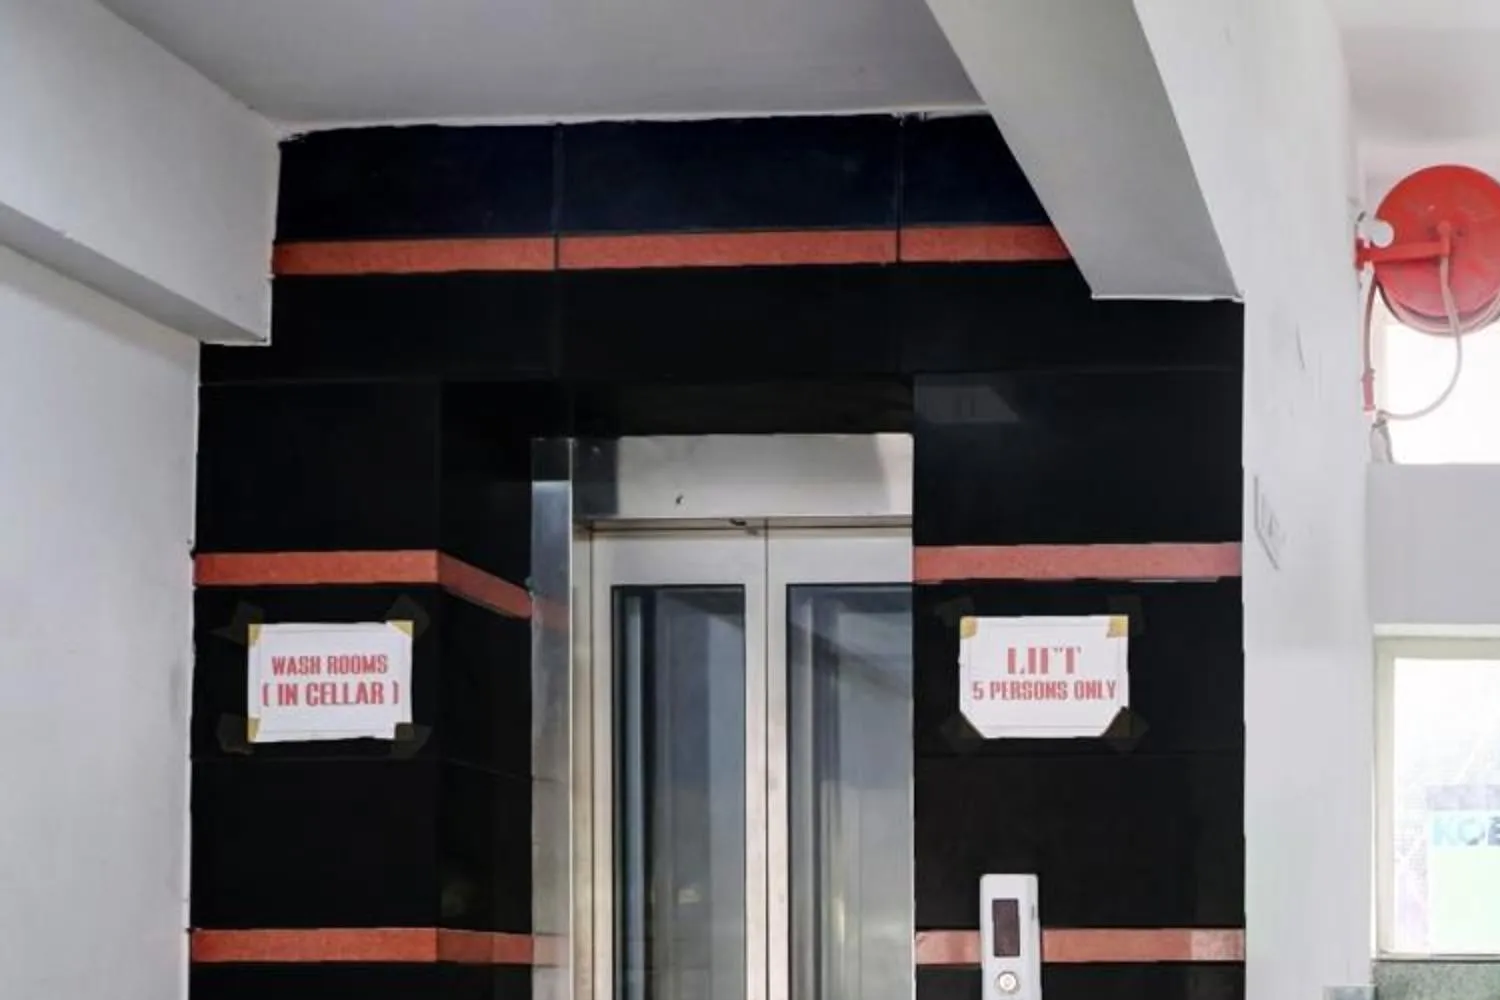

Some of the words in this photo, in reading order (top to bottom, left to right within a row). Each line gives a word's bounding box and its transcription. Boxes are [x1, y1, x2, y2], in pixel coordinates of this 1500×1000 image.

[271, 655, 321, 676] WASH
[327, 654, 388, 675] ROOMS
[1007, 646, 1082, 675] LIFT
[305, 681, 384, 707] CELLAR
[972, 681, 985, 700] 5
[989, 680, 1069, 701] PERSONS
[1073, 680, 1117, 700] ONLY
